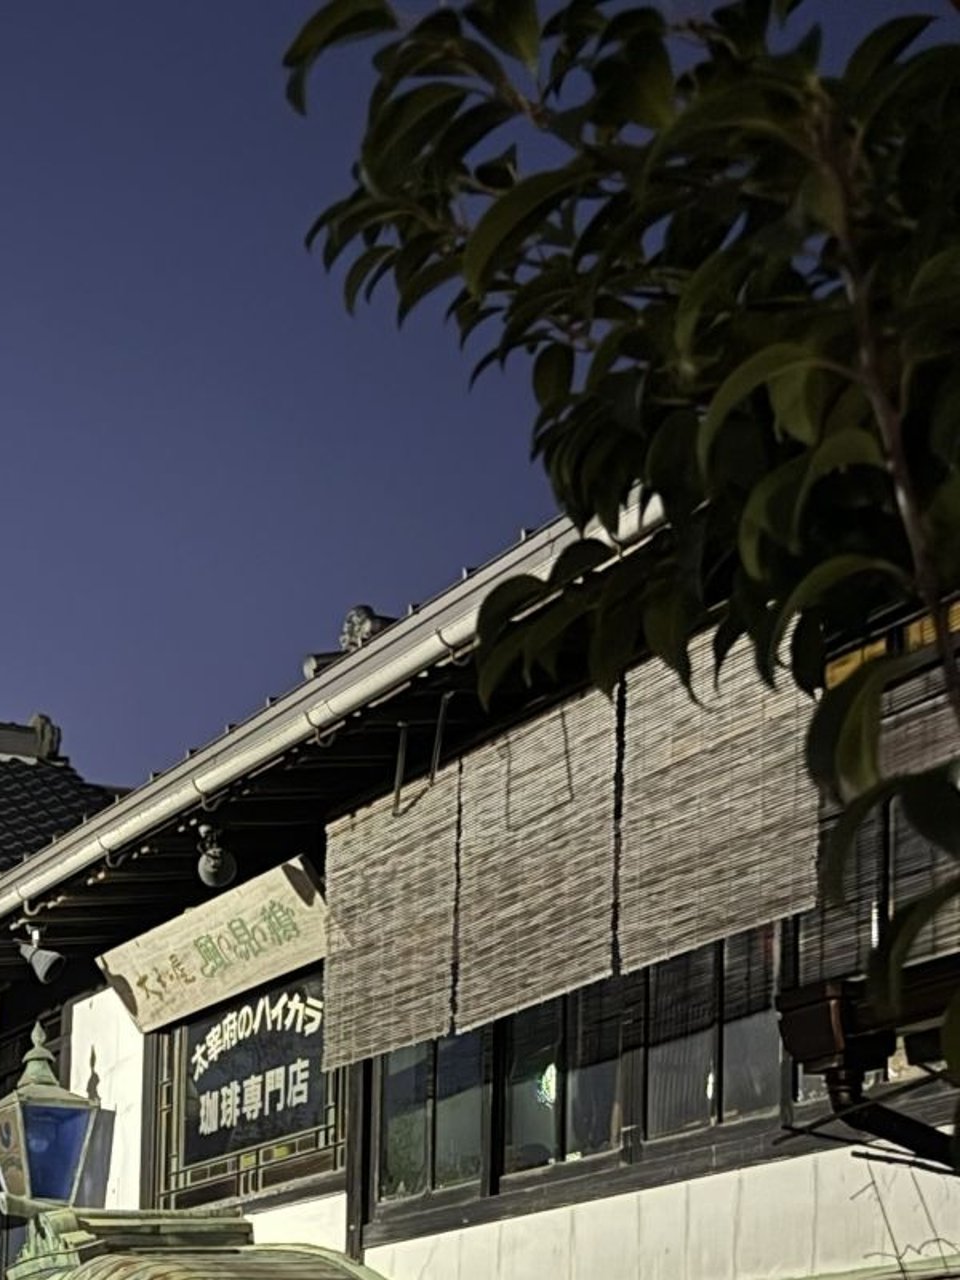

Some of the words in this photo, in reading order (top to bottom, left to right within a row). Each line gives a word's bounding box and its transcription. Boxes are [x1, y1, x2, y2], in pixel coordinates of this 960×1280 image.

[191, 992, 324, 1082] 太宰府のハイカラ
[198, 1057, 310, 1136] 珈琲専門店
